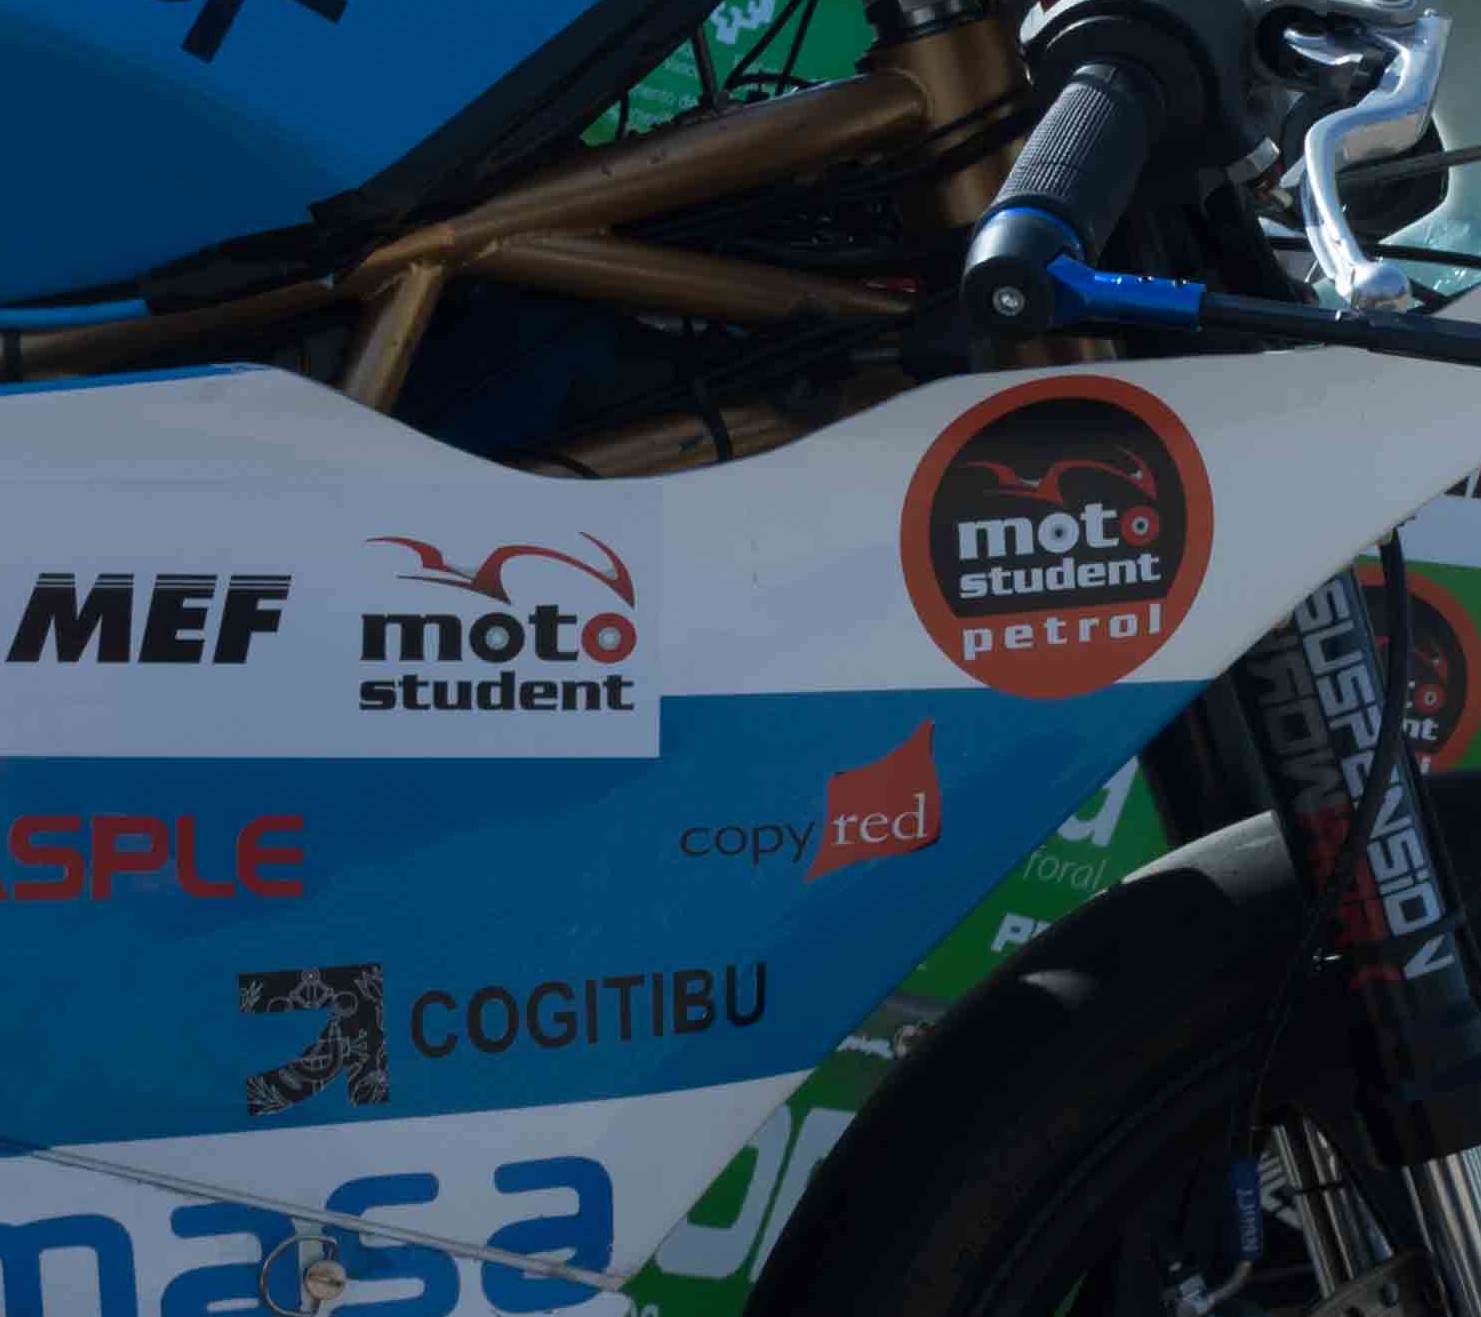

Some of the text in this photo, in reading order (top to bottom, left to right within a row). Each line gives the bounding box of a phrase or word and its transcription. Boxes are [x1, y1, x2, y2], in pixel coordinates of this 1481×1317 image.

[957, 501, 1160, 560] moto
[958, 550, 1161, 599] student
[5, 572, 293, 665] MEF
[361, 602, 637, 665] moto
[962, 602, 1164, 661] petrol
[358, 672, 636, 712] student
[679, 792, 930, 867] copy red
[409, 960, 767, 1059] COGITIBU
